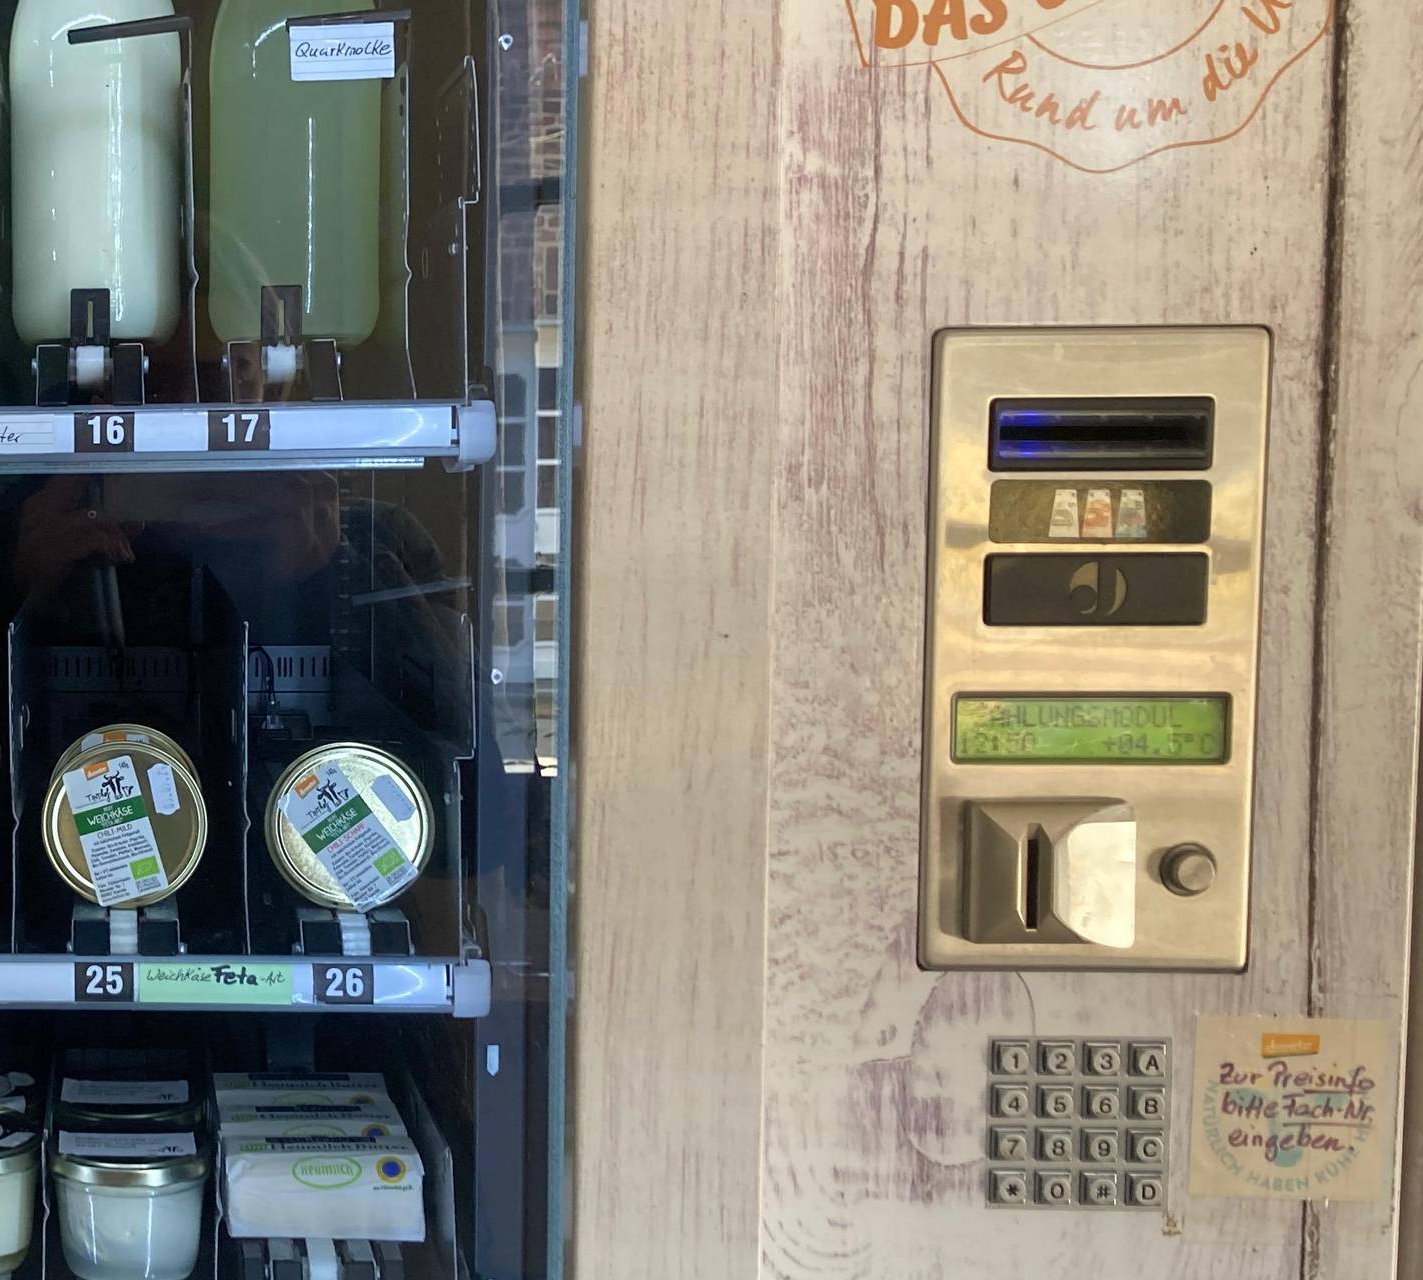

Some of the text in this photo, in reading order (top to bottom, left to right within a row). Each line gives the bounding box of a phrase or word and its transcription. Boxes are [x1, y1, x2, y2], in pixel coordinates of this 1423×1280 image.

[871, 0, 1008, 49] DAS
[982, 41, 1259, 132] Rund um die
[87, 415, 124, 445] 16
[222, 413, 259, 443] 17
[980, 703, 1184, 729] AHLUNGSMODUL
[86, 805, 134, 826] WEICHKÄSE
[316, 808, 358, 841] WEICHKÄSE
[86, 965, 123, 994] 25
[210, 965, 259, 986] Feta
[325, 968, 364, 997] 26
[1010, 1053, 1160, 1071] 1 2 3 A
[1219, 1060, 1376, 1096] Zur Preisinfo
[1008, 1096, 1159, 1115] 4 5 6 B
[1220, 1090, 1279, 1120] bitte
[1007, 1139, 1158, 1158] 7 8 9 C
[1228, 1122, 1356, 1163] eingeben.
[1050, 1182, 1064, 1200] 0
[1142, 1184, 1156, 1200] D
[1246, 1167, 1310, 1192] HABEN
